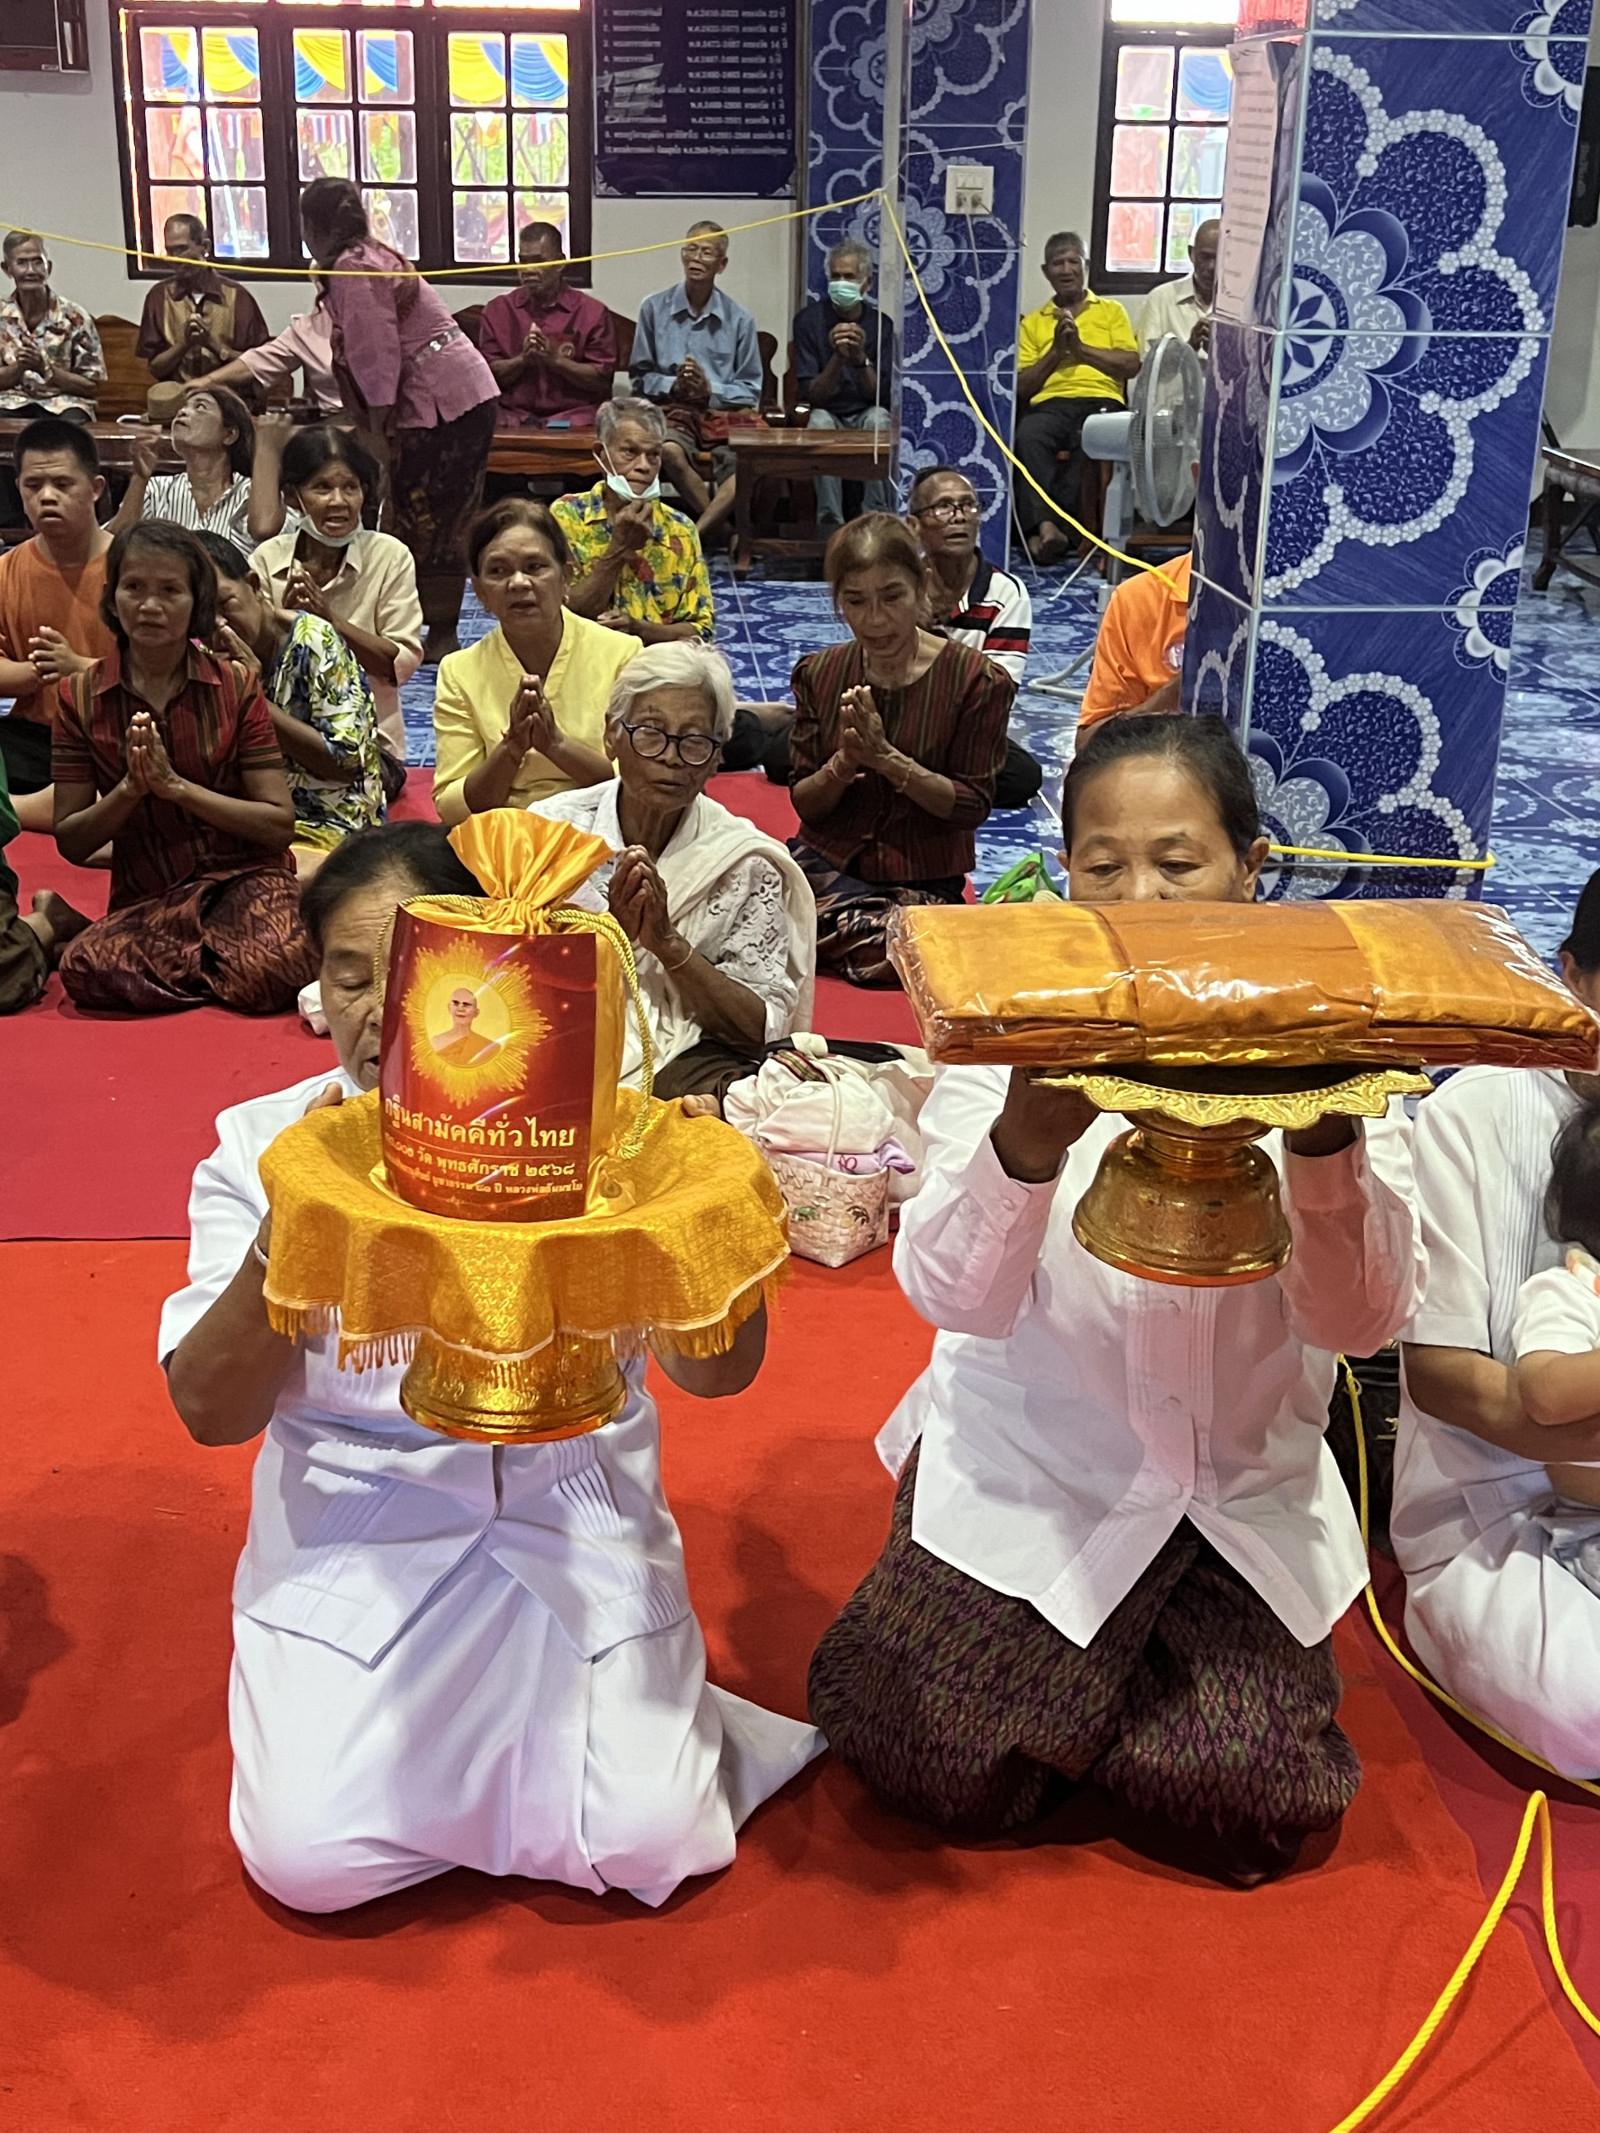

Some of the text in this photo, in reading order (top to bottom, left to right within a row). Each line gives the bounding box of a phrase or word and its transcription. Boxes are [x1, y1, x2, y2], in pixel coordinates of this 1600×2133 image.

[385, 1094, 576, 1147] กฐินสามัคคีทั่วไทย
[417, 1146, 432, 1165] วัด
[436, 1156, 519, 1177] พุทธศักราช
[525, 1162, 575, 1177] ๒๕๖๘
[494, 1182, 503, 1193] ปี
